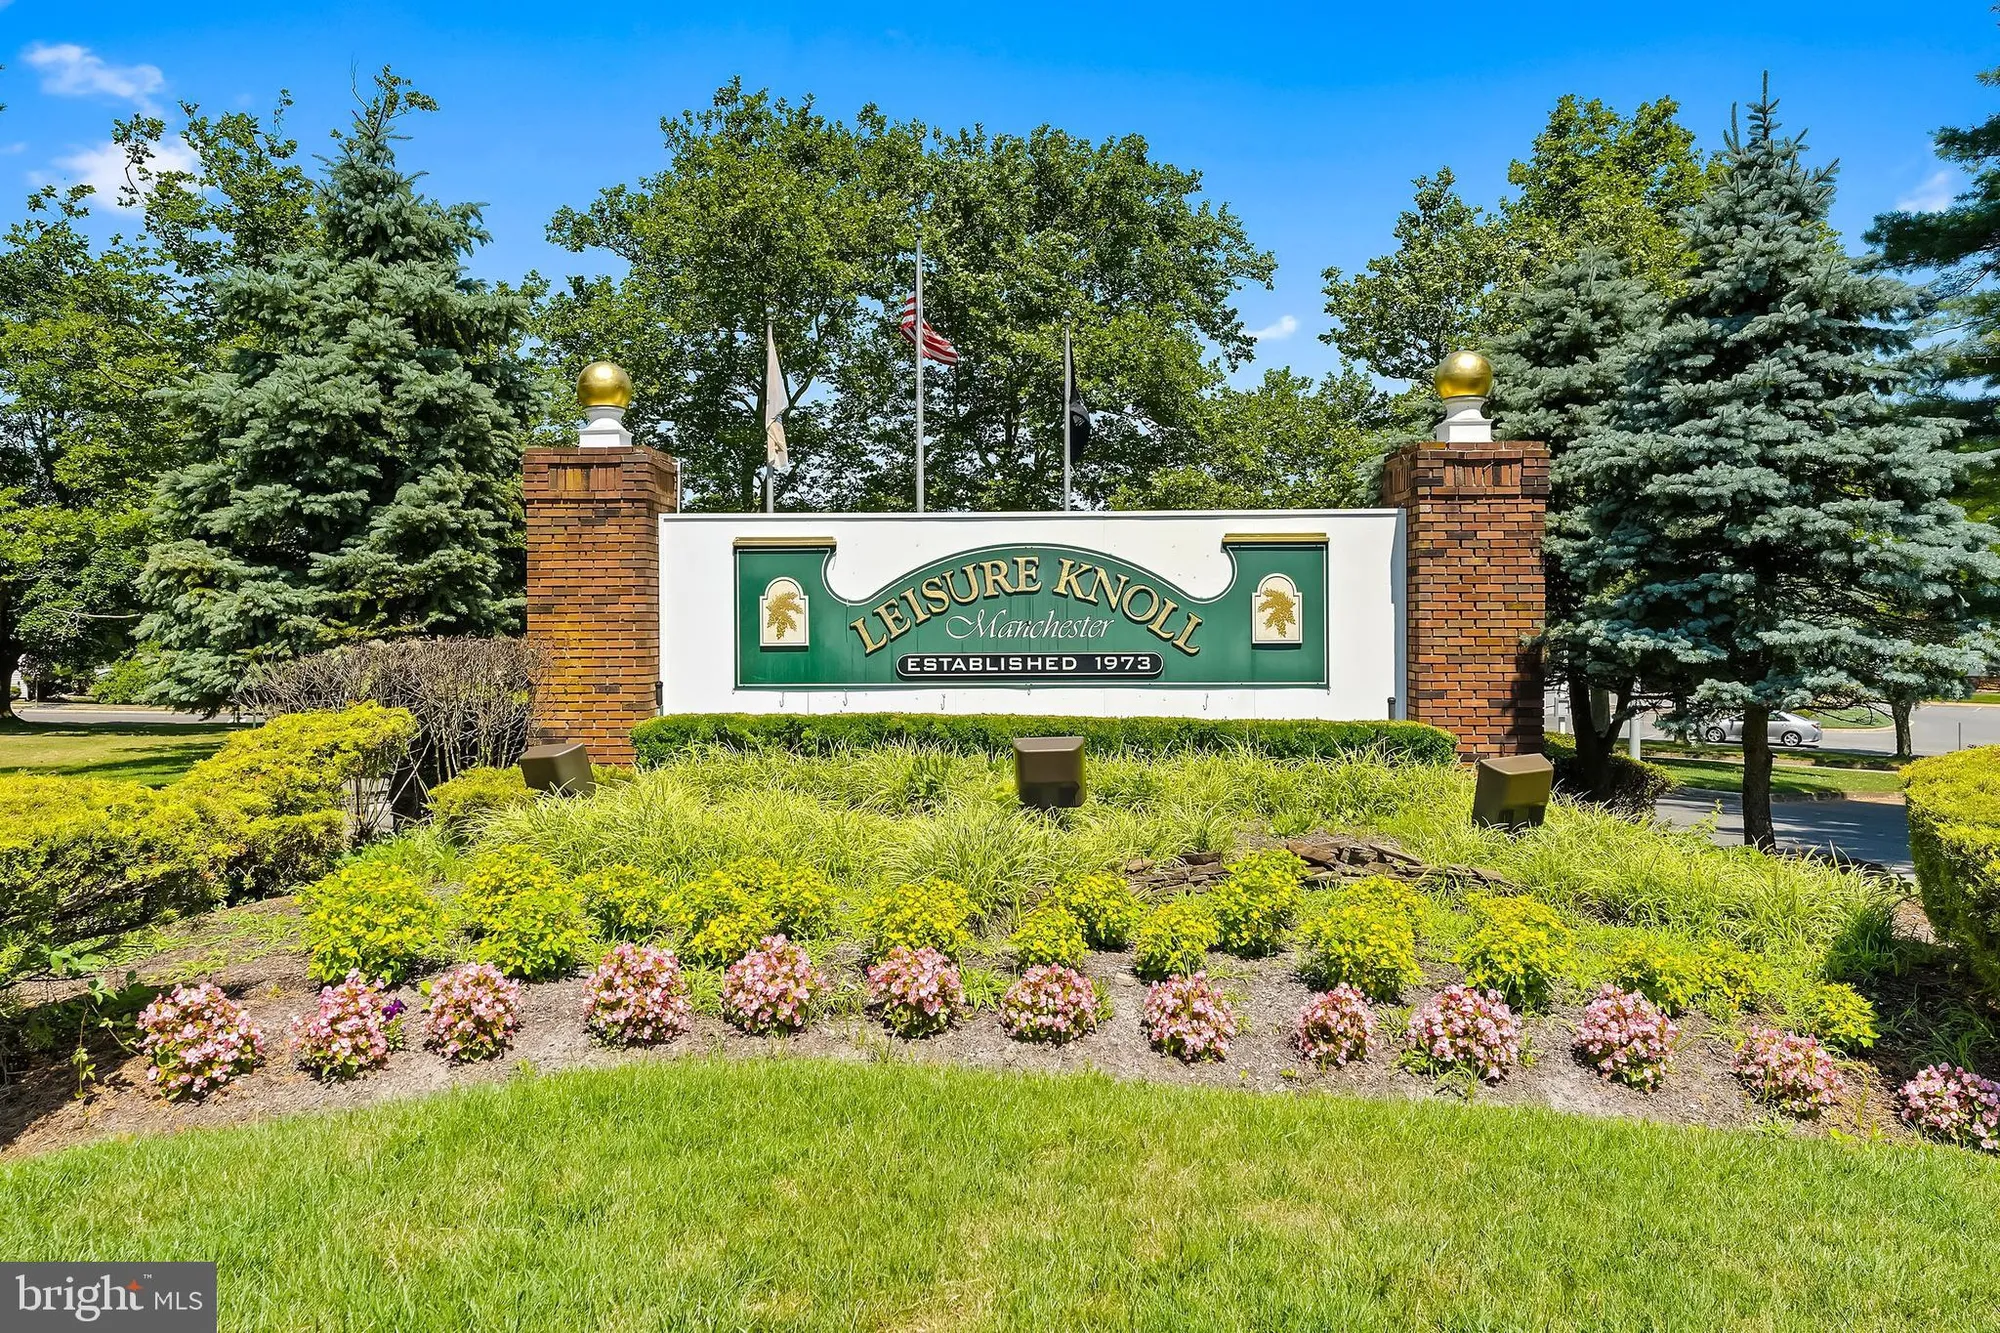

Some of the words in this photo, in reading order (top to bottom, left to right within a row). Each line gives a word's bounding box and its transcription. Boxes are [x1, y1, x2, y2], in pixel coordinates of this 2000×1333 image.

[850, 556, 1042, 655] LEISURE
[1052, 557, 1203, 655] KNOLL
[945, 608, 1115, 639] Manchester
[907, 656, 1077, 672] ESTABLISHED
[1094, 655, 1151, 671] 1973
